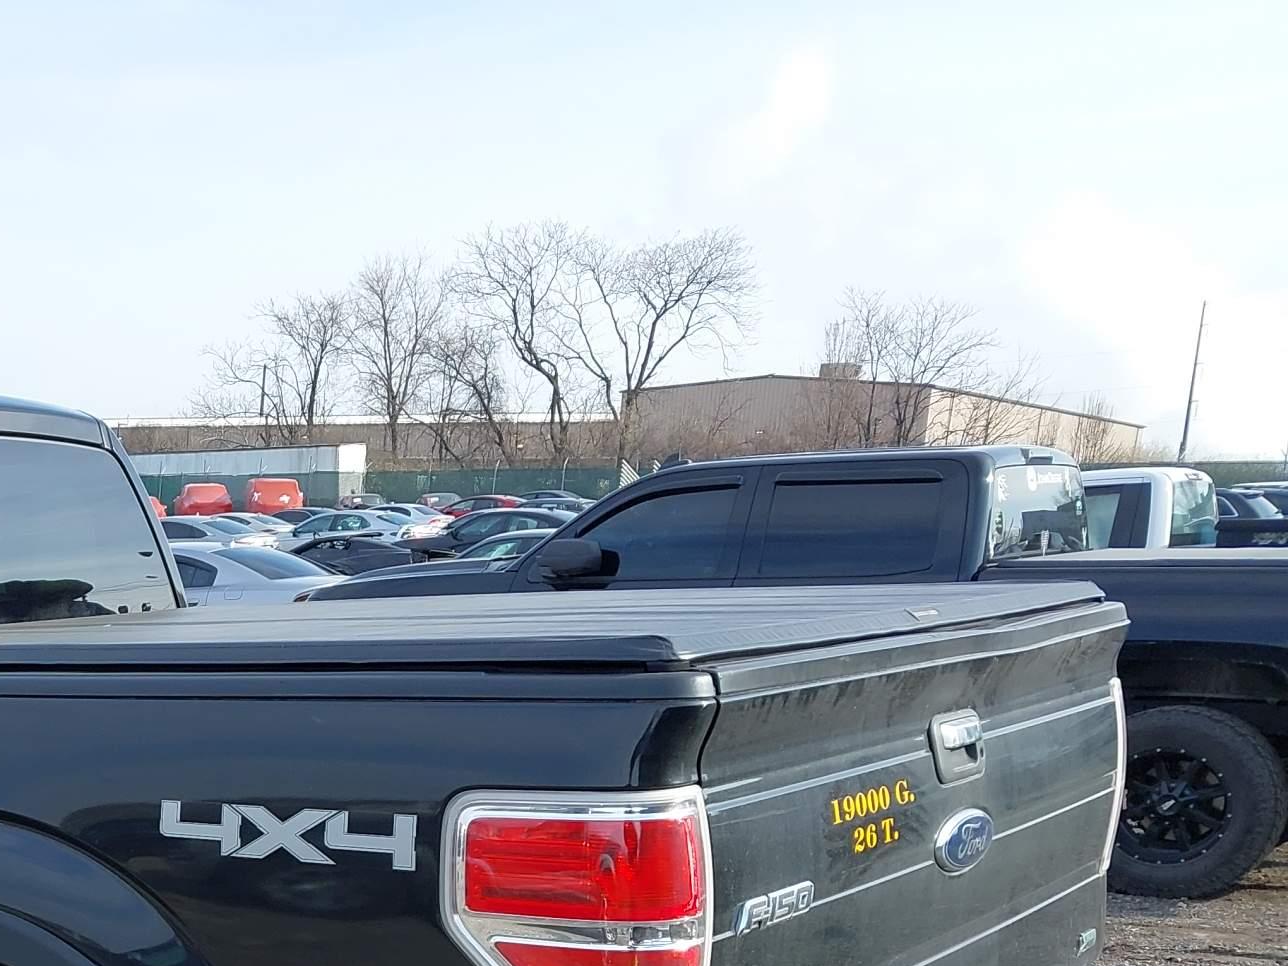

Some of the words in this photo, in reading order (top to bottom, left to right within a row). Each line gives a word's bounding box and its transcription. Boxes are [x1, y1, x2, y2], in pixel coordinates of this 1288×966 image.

[830, 785, 890, 825] 19000
[895, 779, 916, 805] G.
[854, 823, 878, 854] 26
[881, 817, 899, 844] T.
[958, 822, 989, 859] Ford
